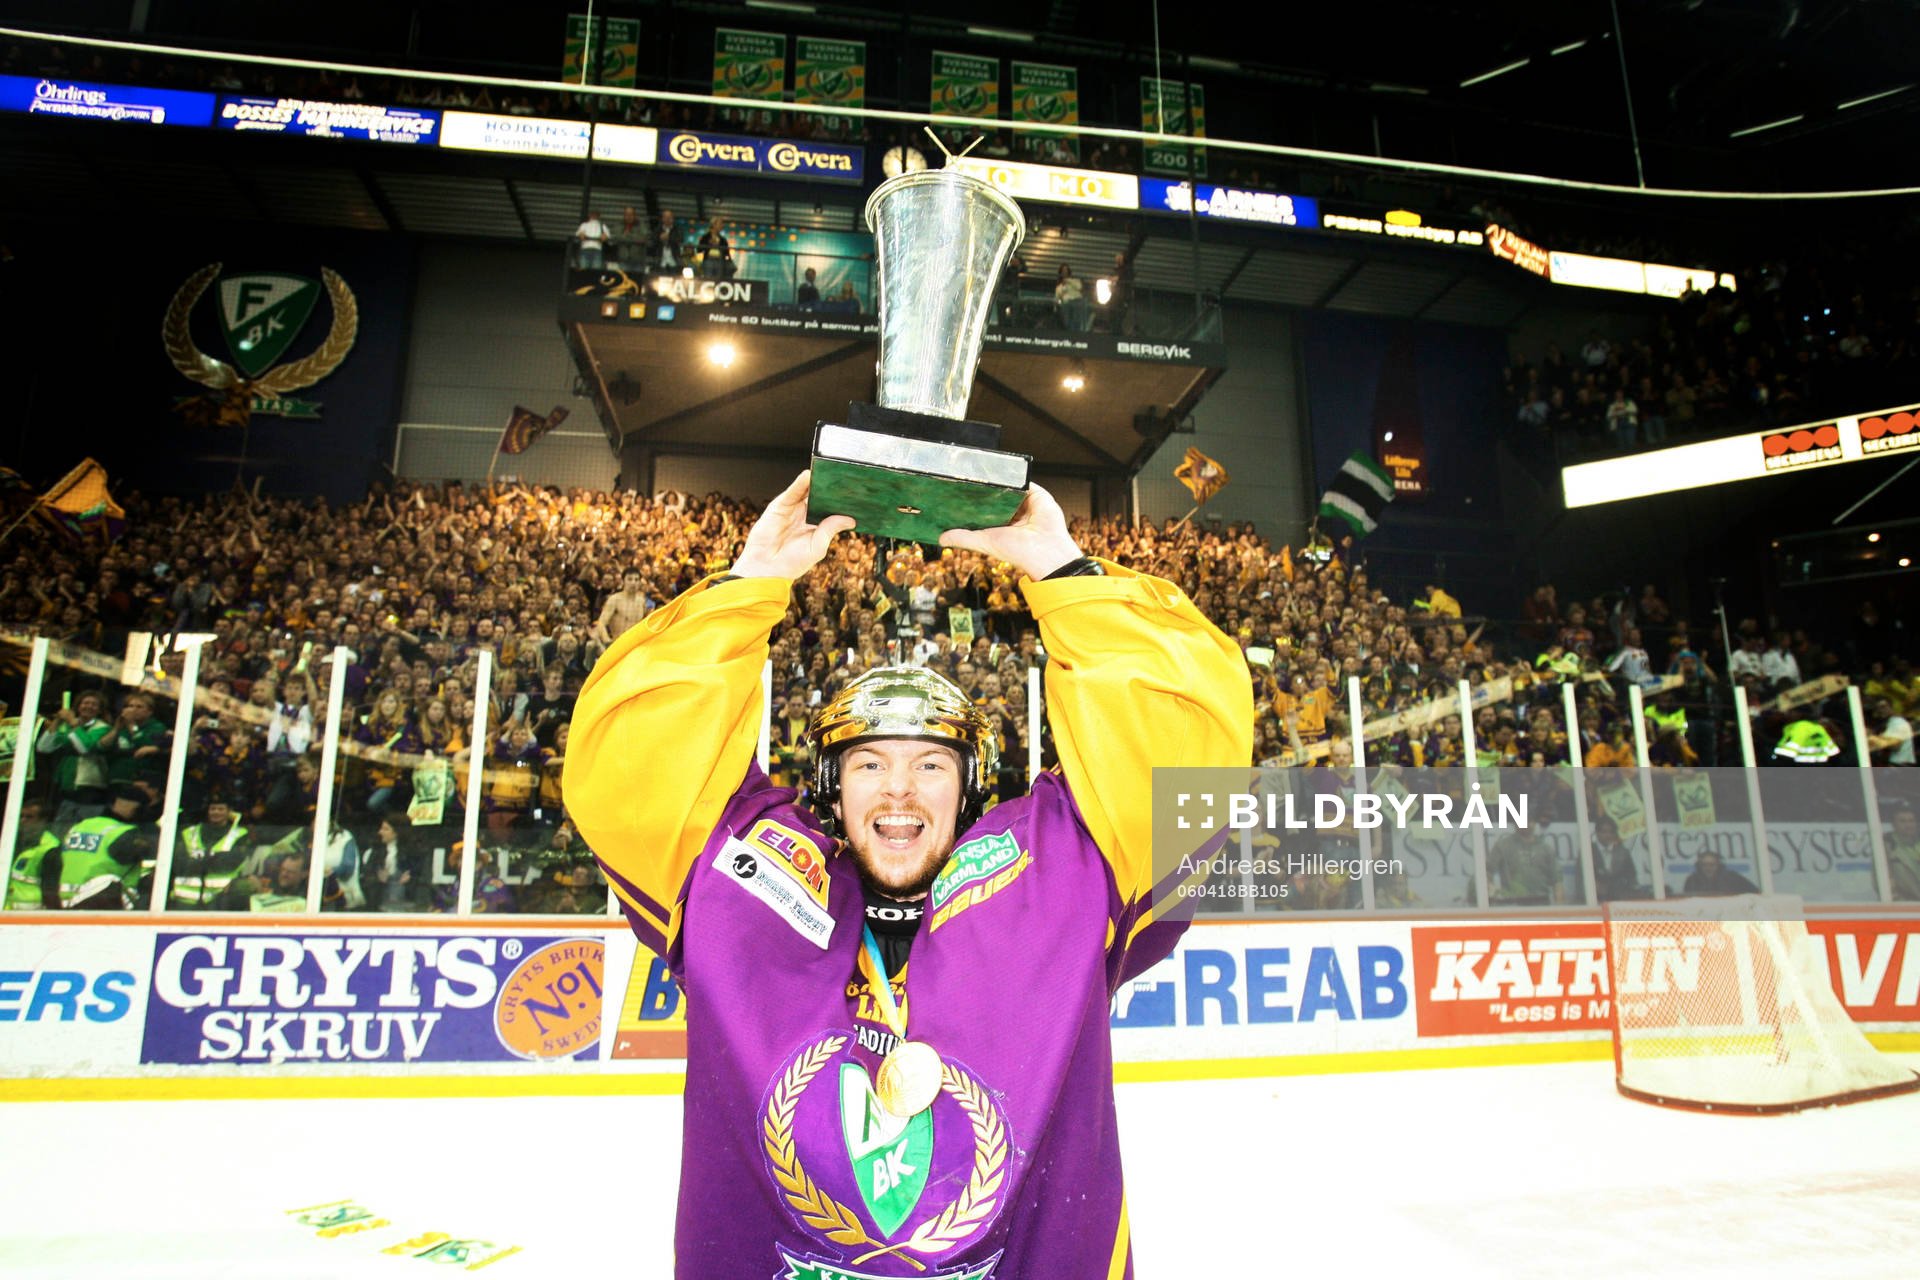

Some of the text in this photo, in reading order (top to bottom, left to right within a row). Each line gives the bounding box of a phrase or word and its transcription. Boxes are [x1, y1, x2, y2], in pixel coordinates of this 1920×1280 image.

[36, 79, 106, 105] Öhrlings
[222, 103, 295, 123] BOSSES
[668, 133, 755, 164] Cervera
[767, 142, 852, 172] Cervera
[236, 282, 273, 322] F
[657, 277, 752, 303] FALCON
[761, 316, 802, 328] butiker
[1117, 341, 1191, 360] BERGVIK
[758, 827, 824, 893] ELON
[1562, 1002, 1582, 1020] is
[199, 1010, 442, 1061] SKRUV
[872, 1138, 917, 1201] BK
